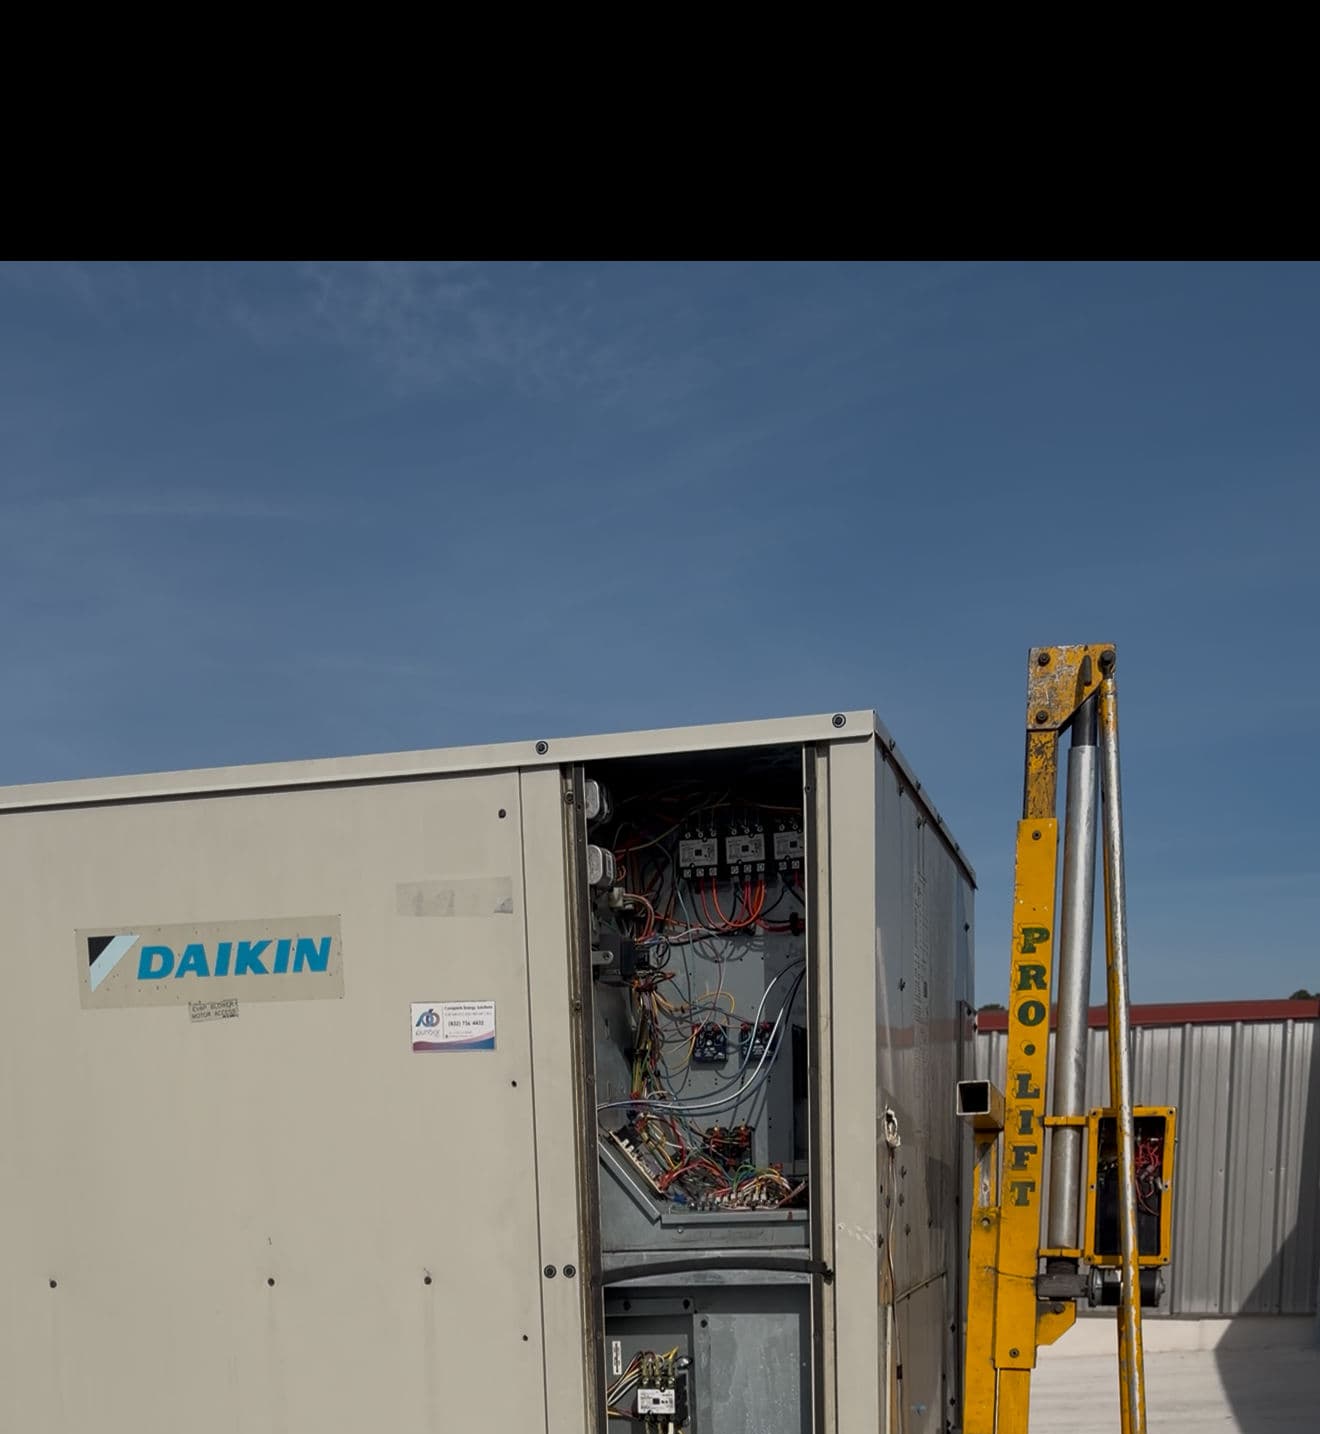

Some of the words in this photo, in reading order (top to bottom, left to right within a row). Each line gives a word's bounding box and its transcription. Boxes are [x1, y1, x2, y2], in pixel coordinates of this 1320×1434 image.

[137, 936, 332, 980] DAIKIN
[1017, 926, 1050, 1027] PRO
[1010, 1073, 1041, 1207] LIFT
